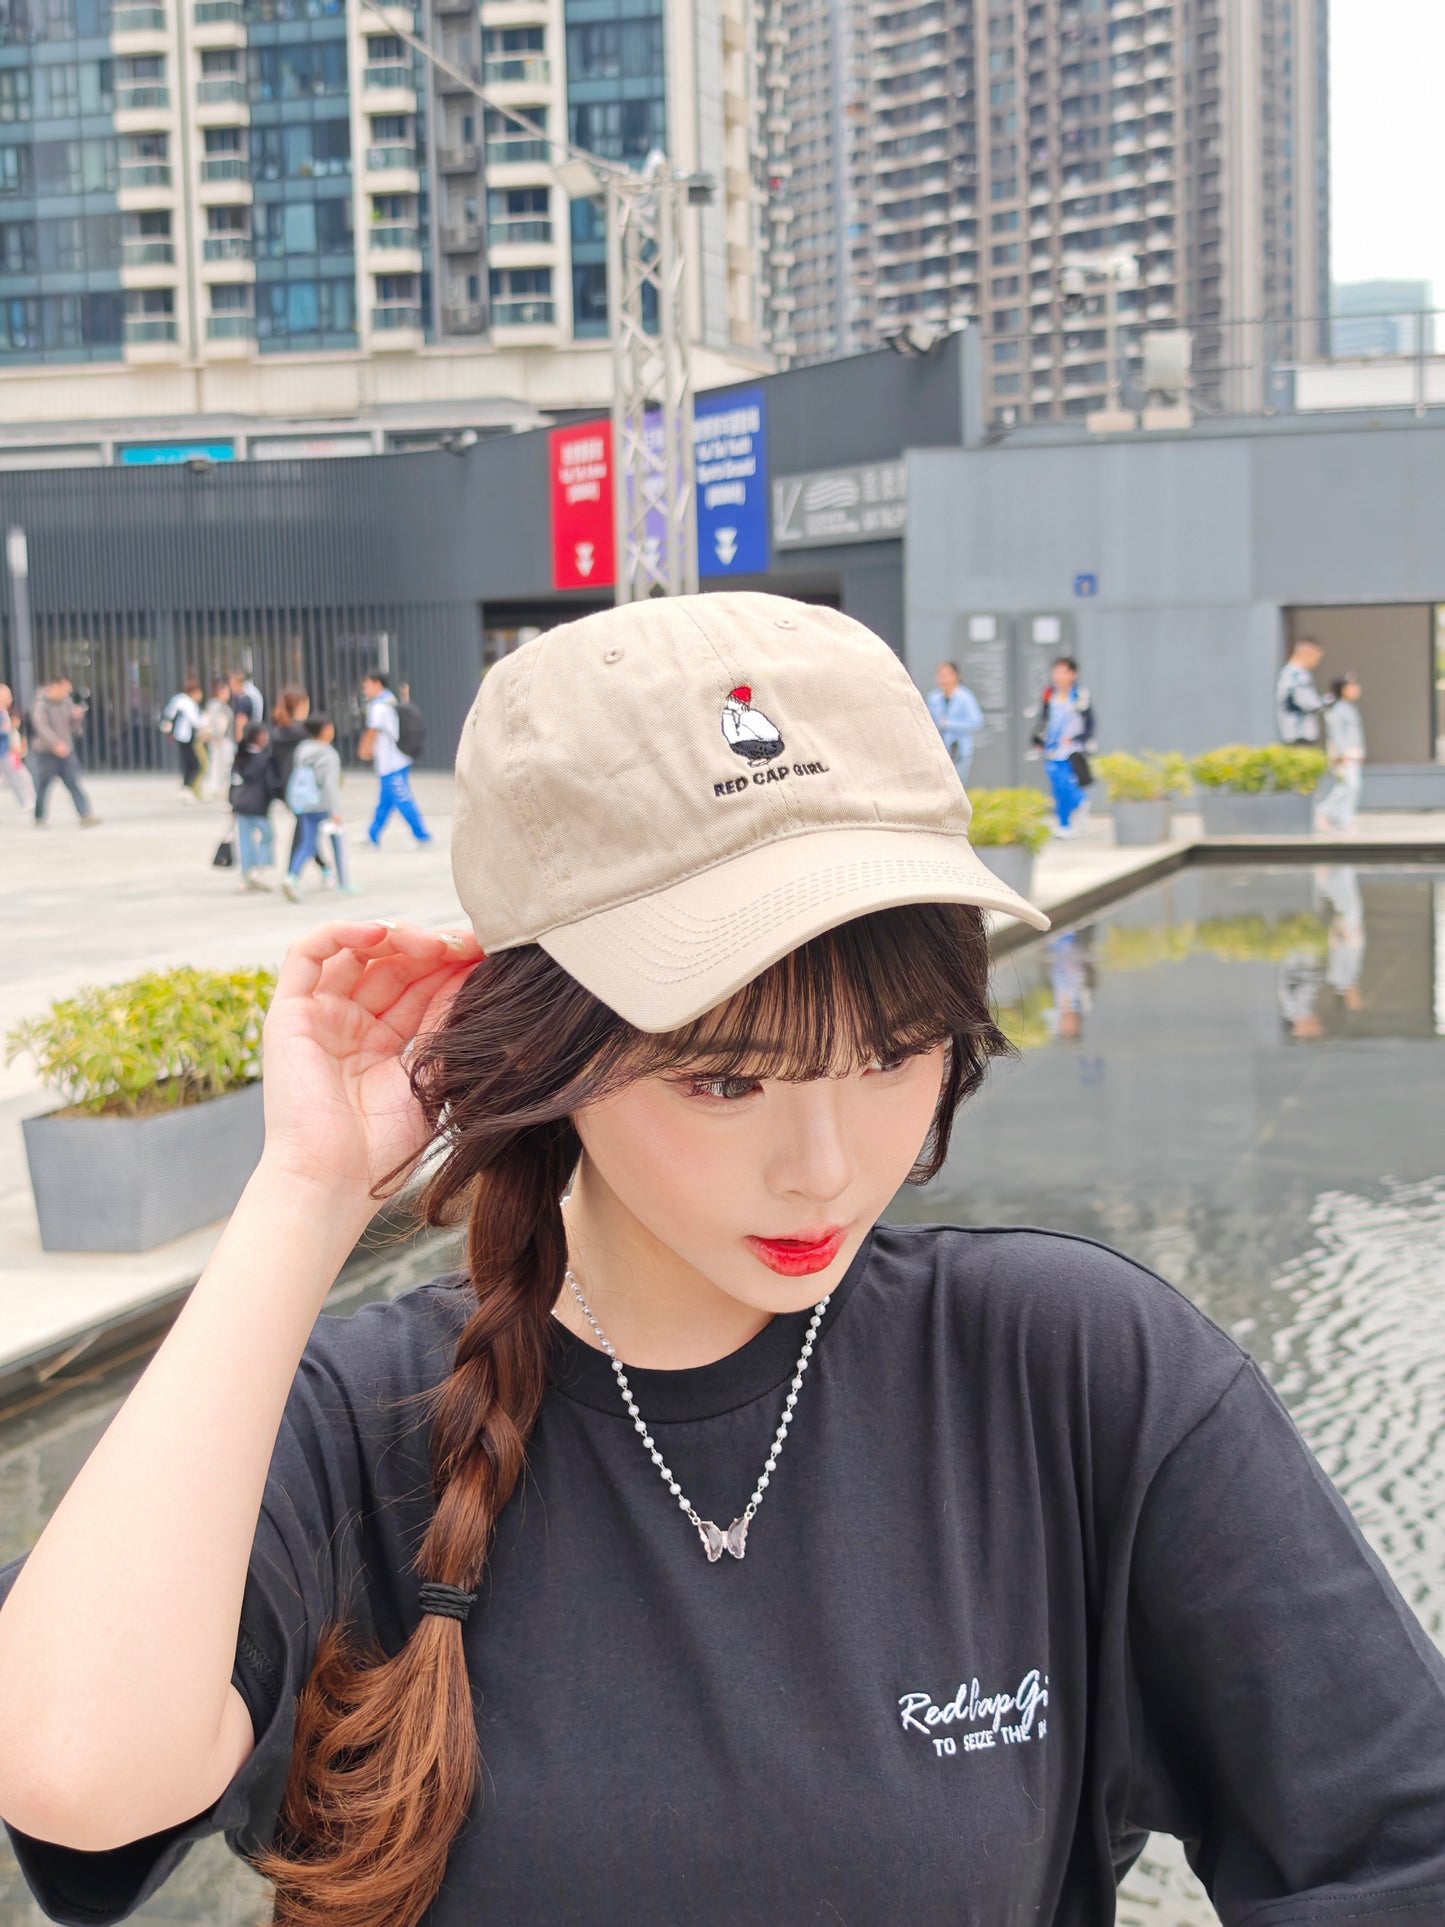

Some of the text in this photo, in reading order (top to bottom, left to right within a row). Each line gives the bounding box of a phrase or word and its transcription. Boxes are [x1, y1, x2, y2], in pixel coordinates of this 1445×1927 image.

[713, 762, 830, 797] RED CAP GIRL
[933, 1737, 957, 1757] TO
[963, 1730, 996, 1752] SEIZE
[1000, 1725, 1031, 1744] THE
